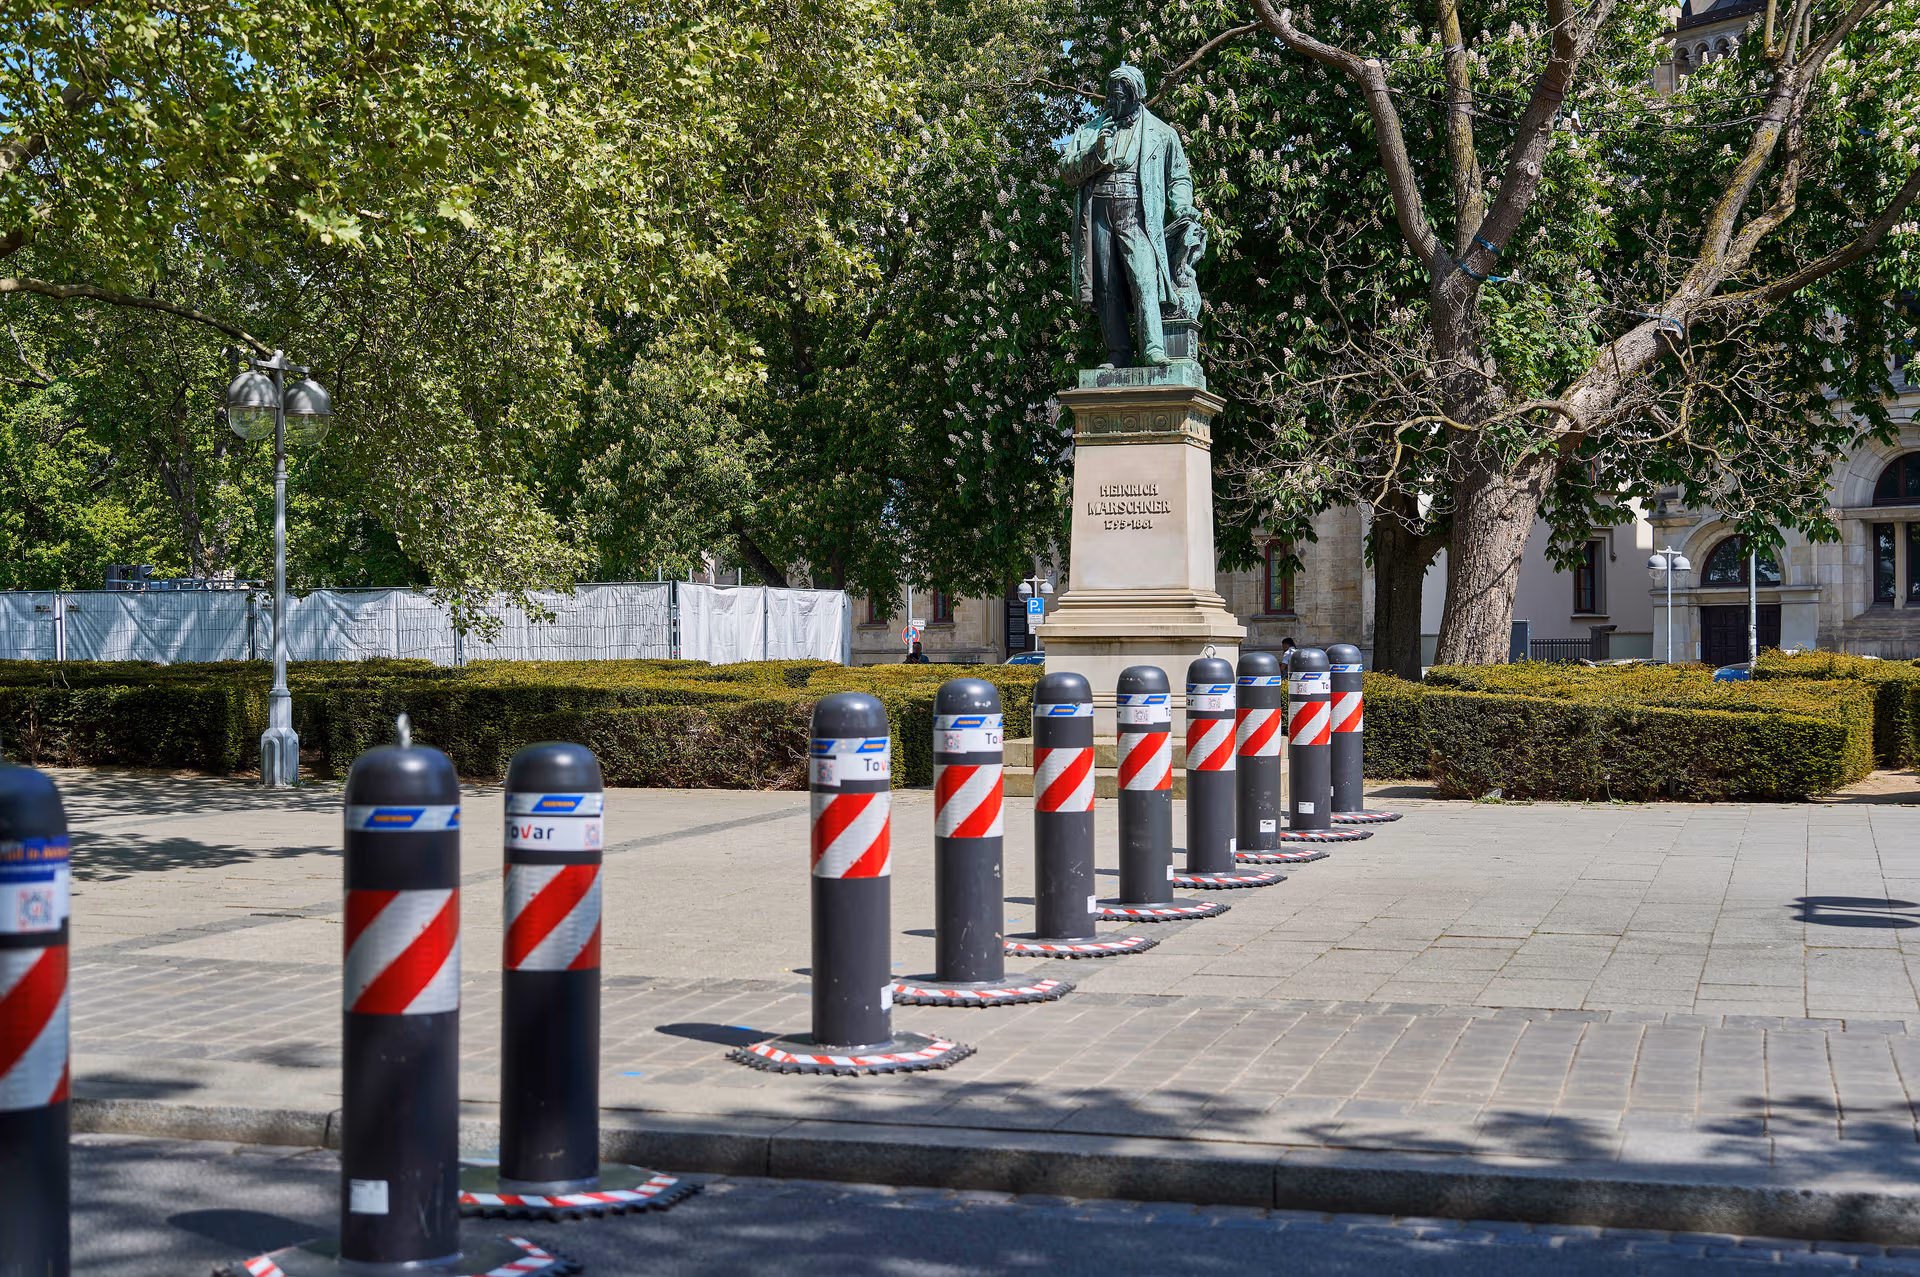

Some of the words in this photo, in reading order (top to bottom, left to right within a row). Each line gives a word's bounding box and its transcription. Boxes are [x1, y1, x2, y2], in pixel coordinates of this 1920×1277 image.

[1099, 484, 1158, 497] HEINRICH
[1087, 501, 1171, 515] MARSCHNER
[1103, 520, 1153, 530] 1795-1861
